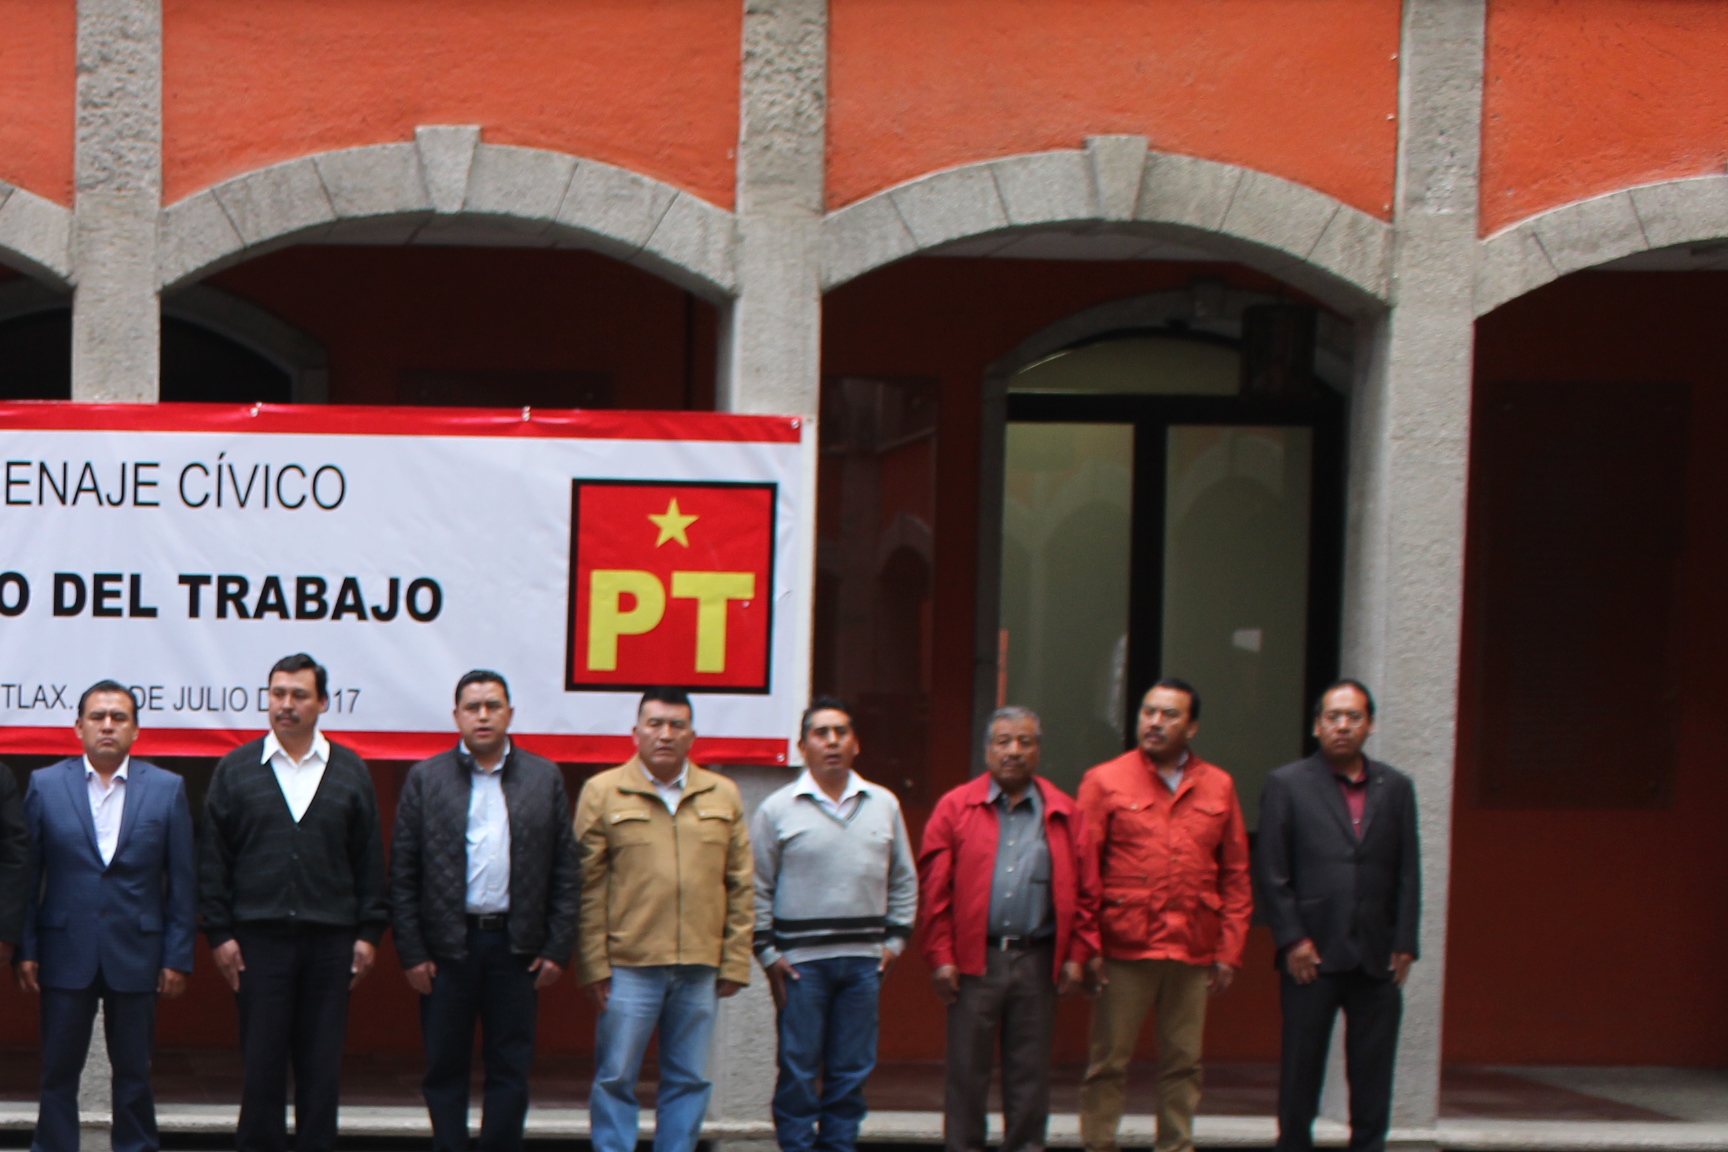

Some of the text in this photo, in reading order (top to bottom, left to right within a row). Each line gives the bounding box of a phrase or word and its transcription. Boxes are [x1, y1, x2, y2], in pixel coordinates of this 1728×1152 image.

[178, 452, 347, 510] CÍVICO
[52, 571, 158, 618] DEL
[178, 573, 443, 623] TRABAJO
[586, 568, 757, 674] PT
[1, 684, 74, 709] TLAX.
[173, 685, 249, 712] JULIO
